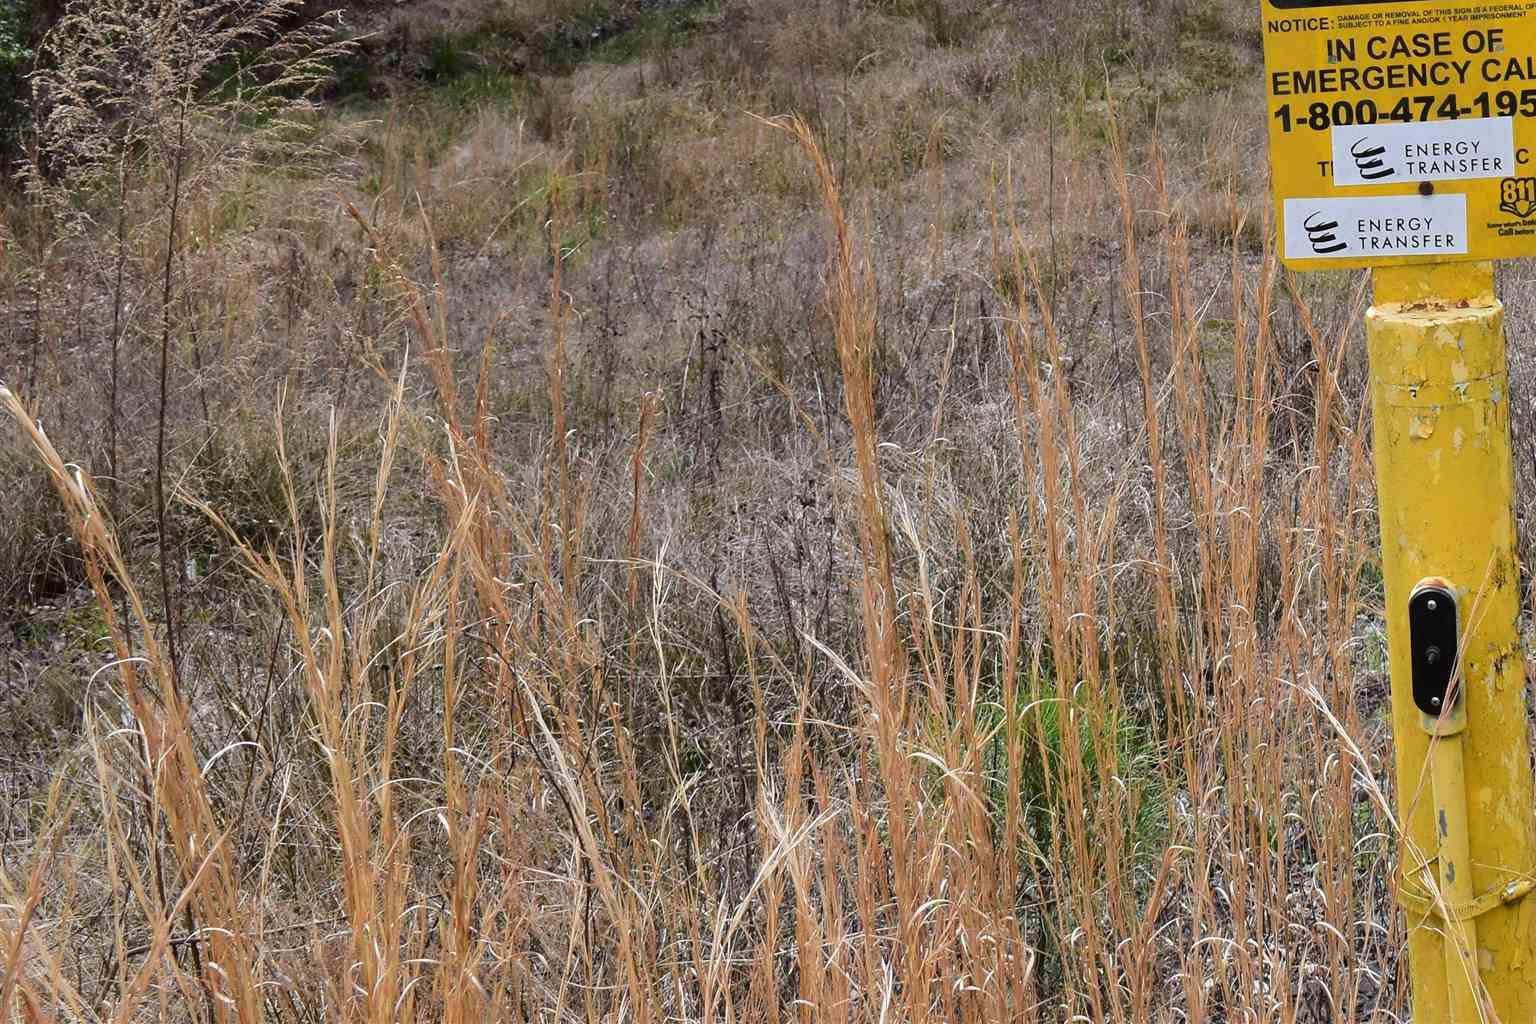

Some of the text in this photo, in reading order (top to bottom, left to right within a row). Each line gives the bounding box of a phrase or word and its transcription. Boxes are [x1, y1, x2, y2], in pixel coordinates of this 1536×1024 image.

[1372, 12, 1383, 20] OR
[1385, 10, 1420, 19] REMOVAL
[1423, 9, 1432, 17] OF
[1436, 8, 1452, 16] THIS
[1454, 7, 1472, 15] SIGN
[1489, 3, 1523, 12] FEDERAL
[1268, 17, 1335, 33] NOTICE:
[1327, 28, 1503, 62] IN CASE OF
[1272, 61, 1472, 96] EMERGENCY
[1405, 141, 1481, 158] ENERGY
[1406, 157, 1503, 175] TRANSFER
[1358, 217, 1434, 233] ENERGY
[1359, 234, 1456, 250] TRANSFER
